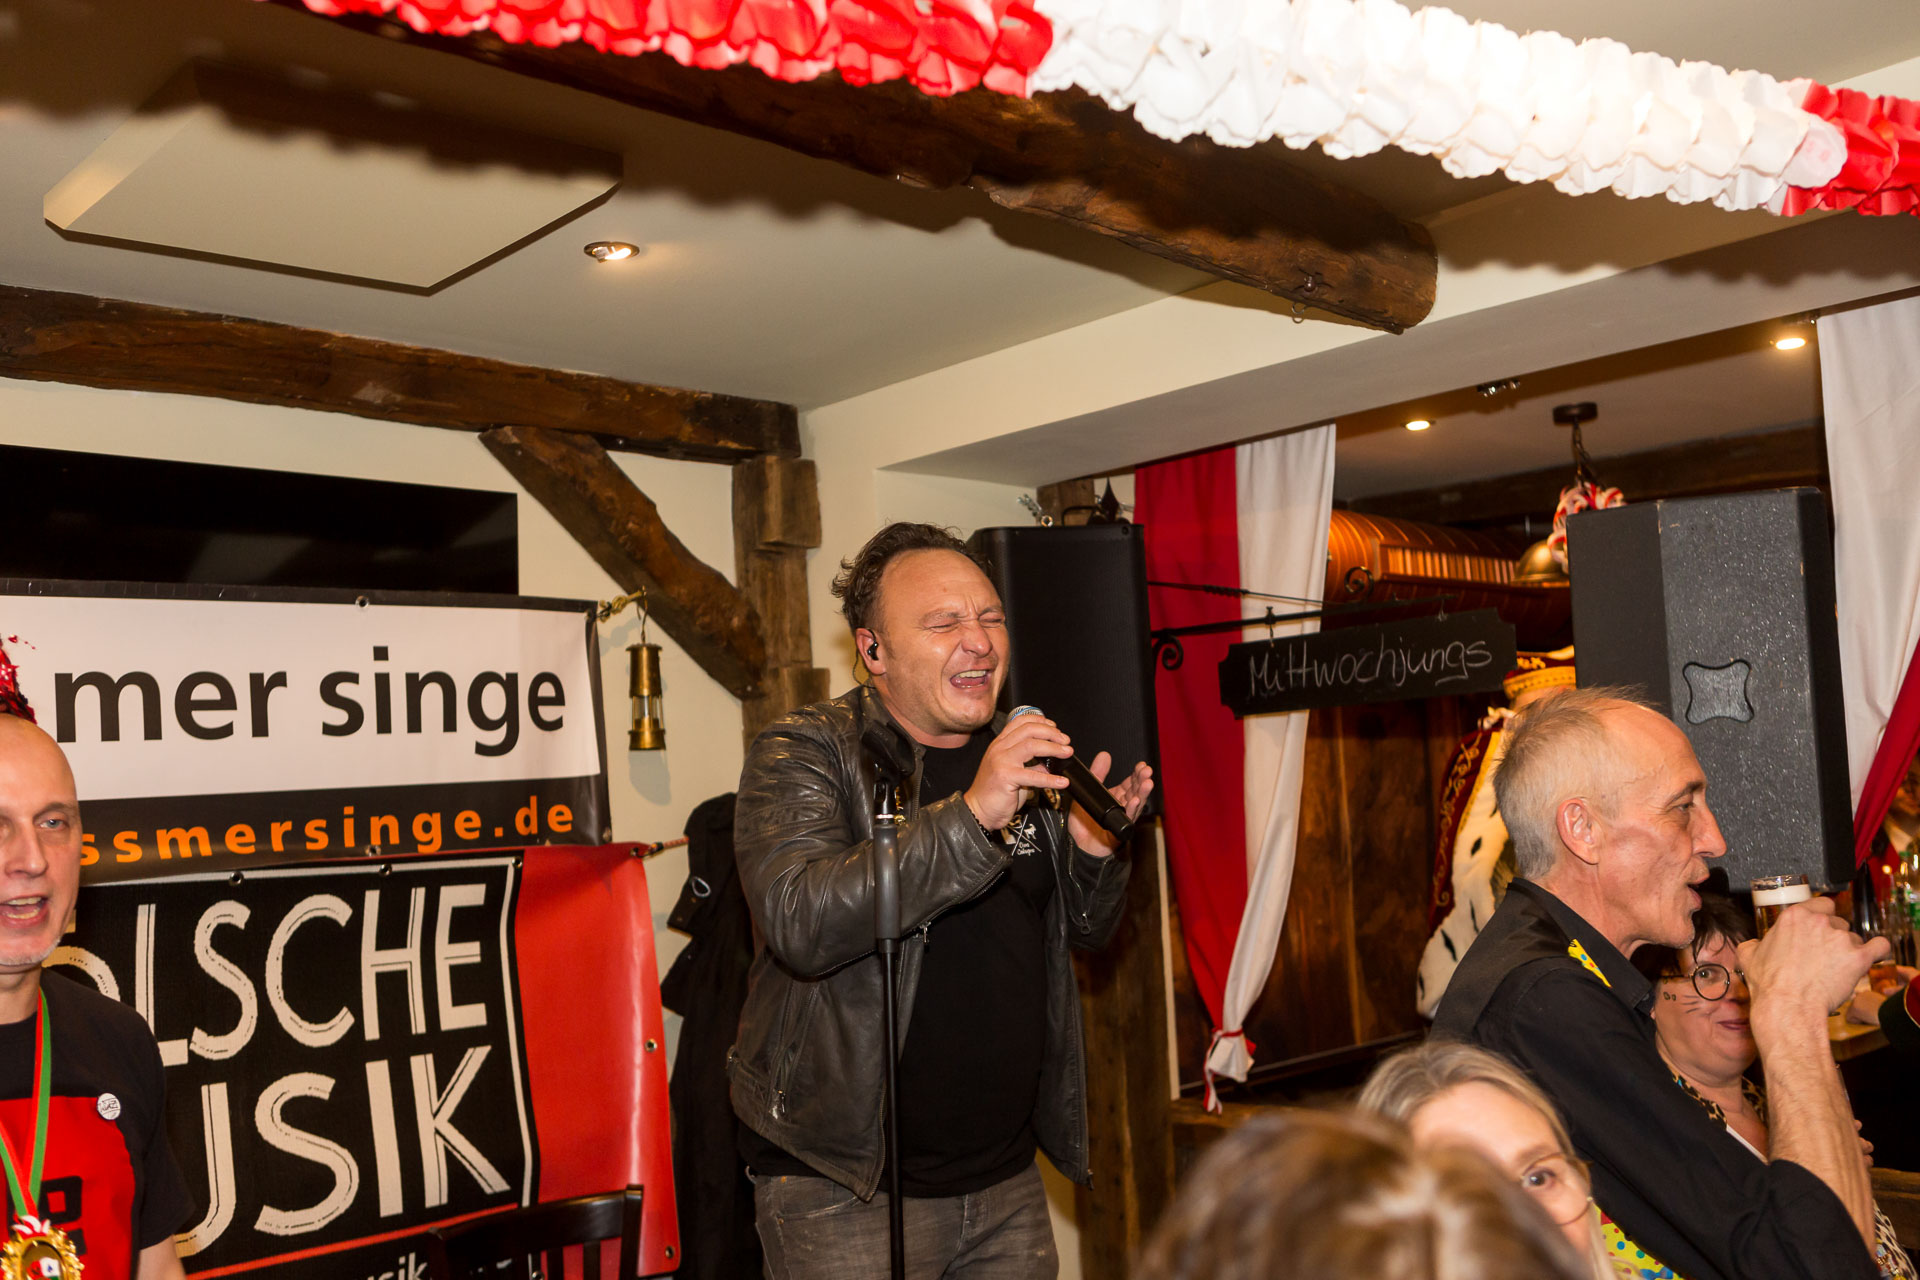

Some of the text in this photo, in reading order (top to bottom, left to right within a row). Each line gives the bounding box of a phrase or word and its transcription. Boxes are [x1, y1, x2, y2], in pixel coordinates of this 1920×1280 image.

[54, 646, 566, 757] mer singe
[1250, 633, 1492, 696] Mittwochjungs
